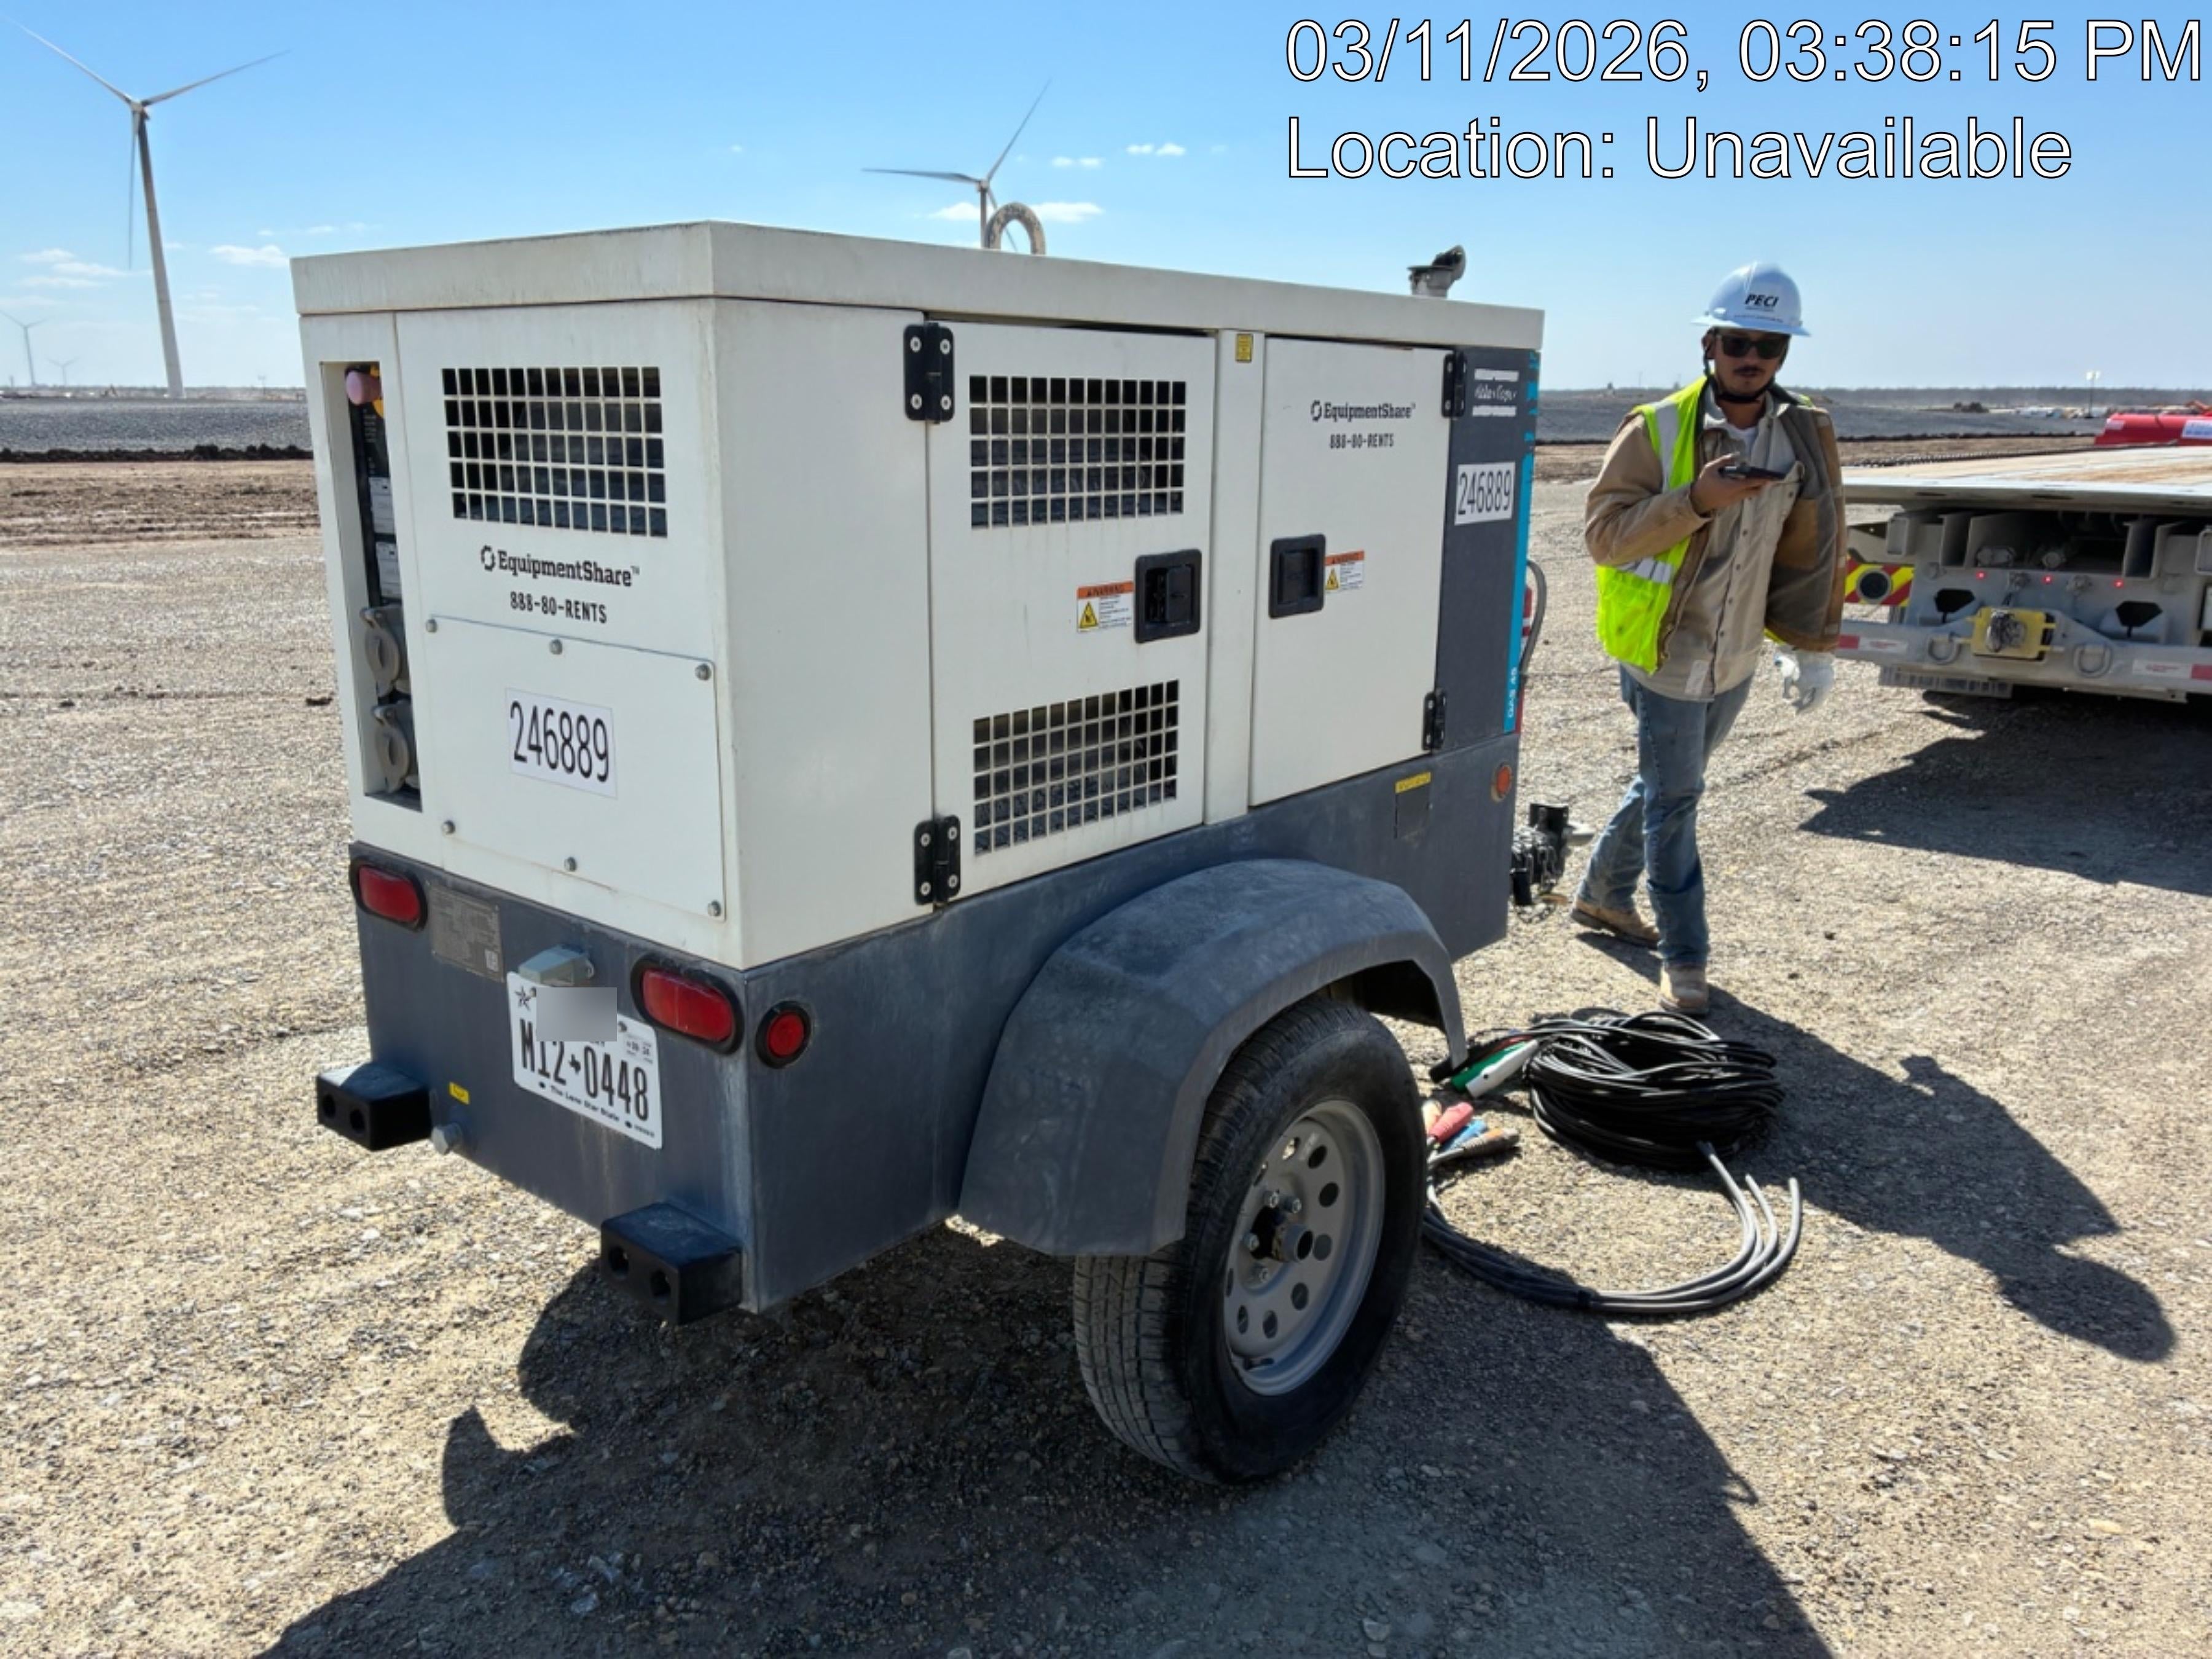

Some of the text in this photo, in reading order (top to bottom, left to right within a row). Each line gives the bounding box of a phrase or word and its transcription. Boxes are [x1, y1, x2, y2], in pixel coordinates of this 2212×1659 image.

[1745, 294, 1779, 307] PECI
[1324, 402, 1411, 422] EquipmentShare
[1330, 433, 1394, 449] 888-80-RENTS
[1458, 470, 1511, 515] 246889
[497, 550, 632, 587] EquipmentShare
[510, 590, 607, 624] 888-80-RENTS
[510, 700, 609, 782] 246889
[584, 1045, 649, 1121] 0448
